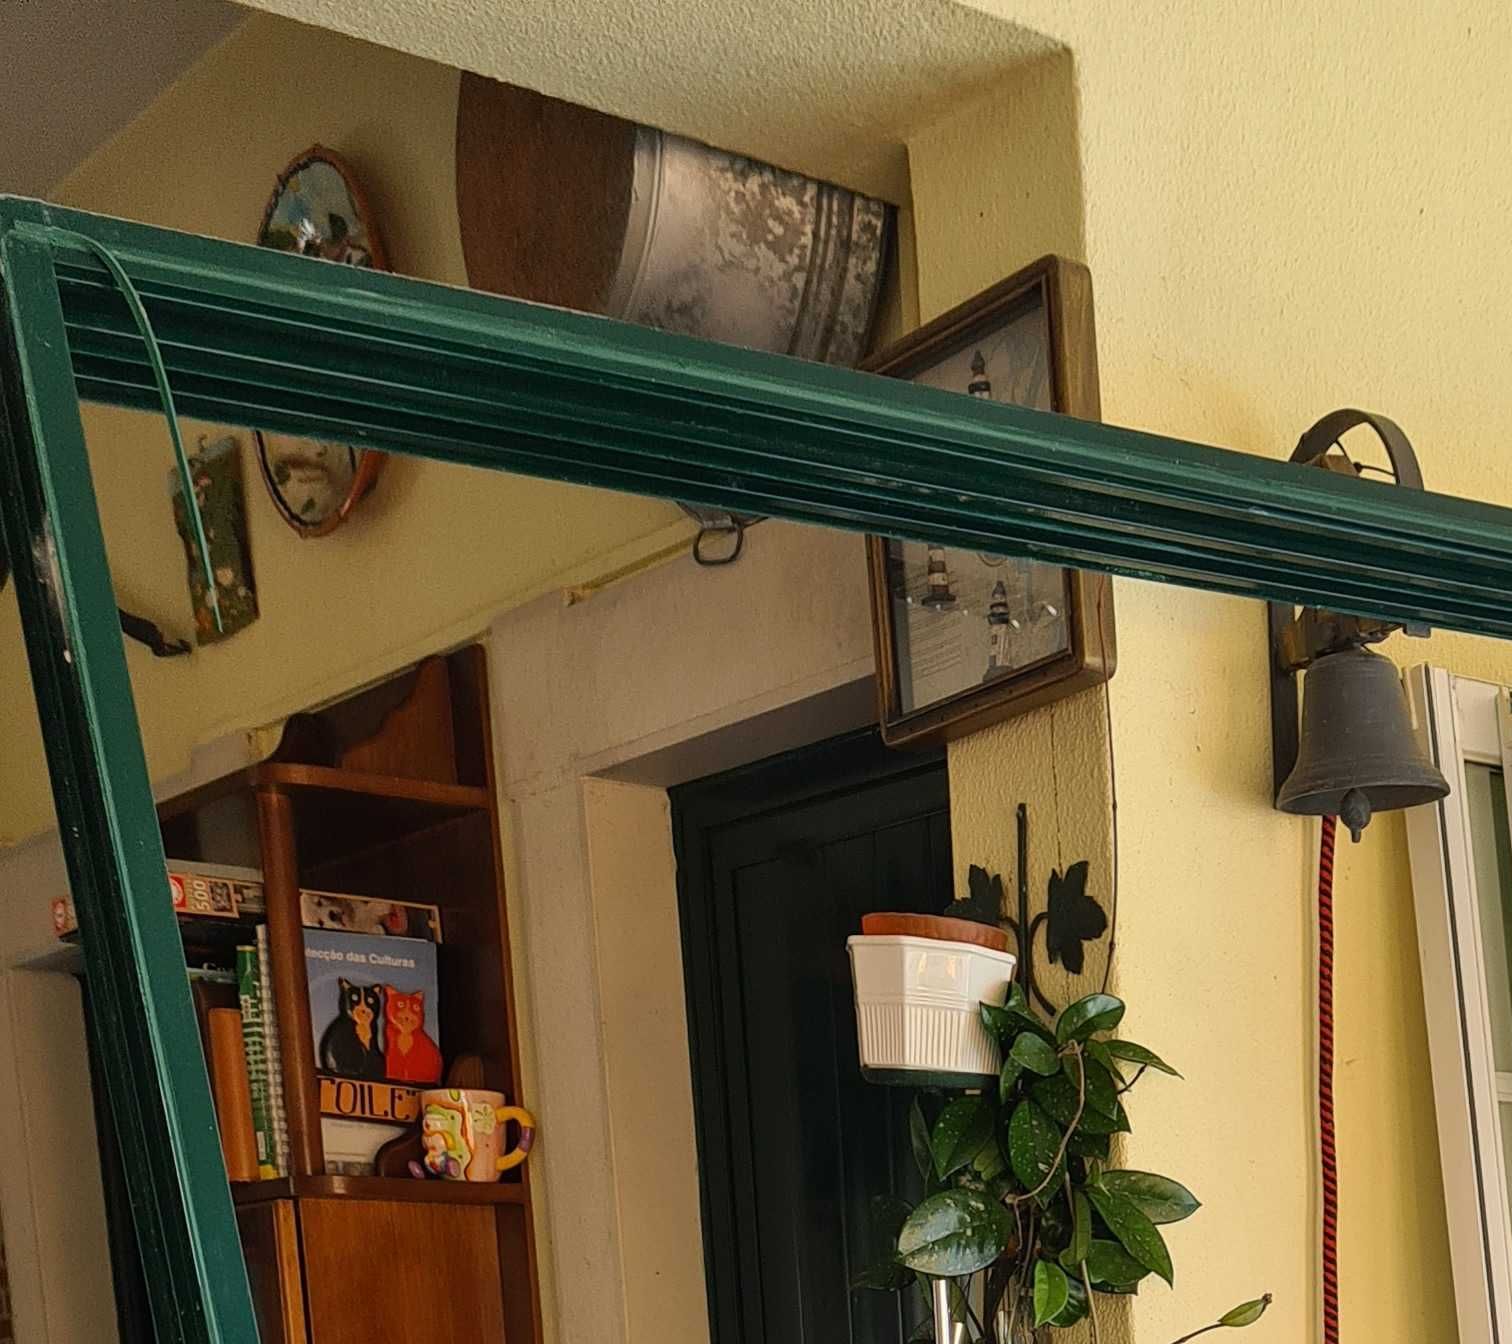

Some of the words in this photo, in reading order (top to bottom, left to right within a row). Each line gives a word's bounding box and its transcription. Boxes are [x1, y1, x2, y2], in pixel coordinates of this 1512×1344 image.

[192, 879, 211, 911] 500
[346, 949, 367, 963] das
[368, 953, 416, 969] Culturas
